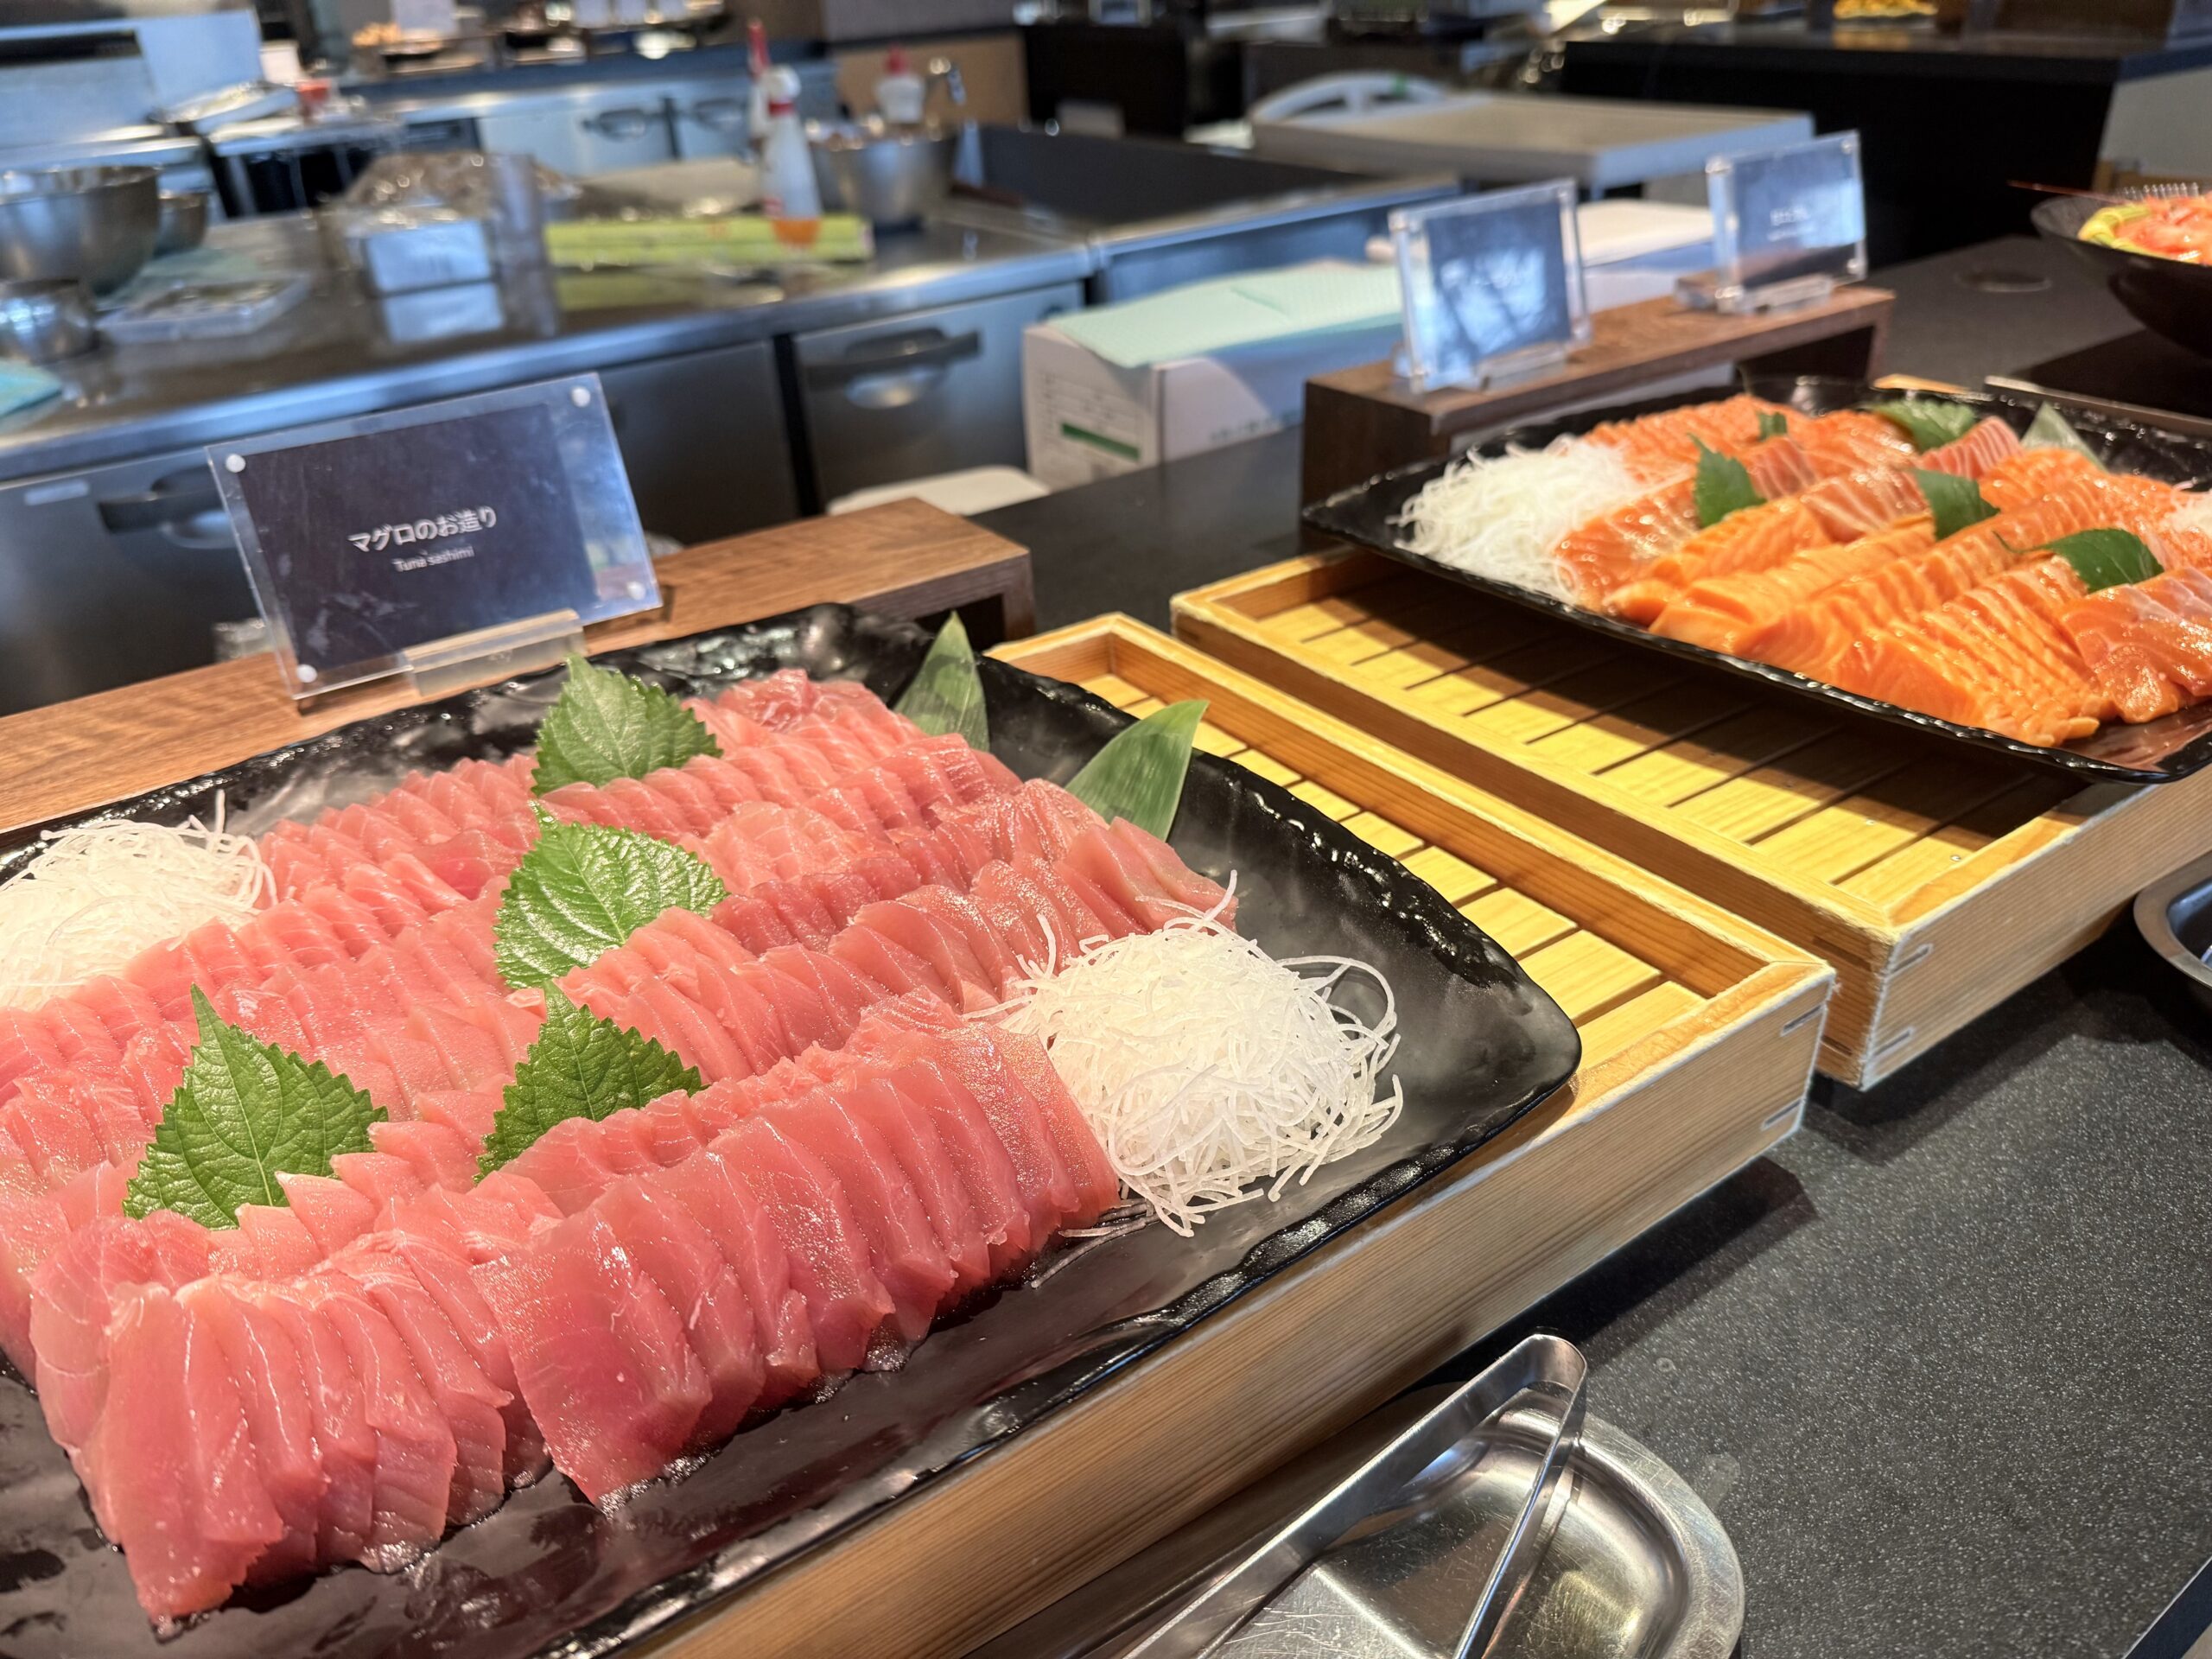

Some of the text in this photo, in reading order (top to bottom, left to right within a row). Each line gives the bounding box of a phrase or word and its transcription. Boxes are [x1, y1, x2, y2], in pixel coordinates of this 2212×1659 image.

[347, 505, 496, 552] マグロのお造り
